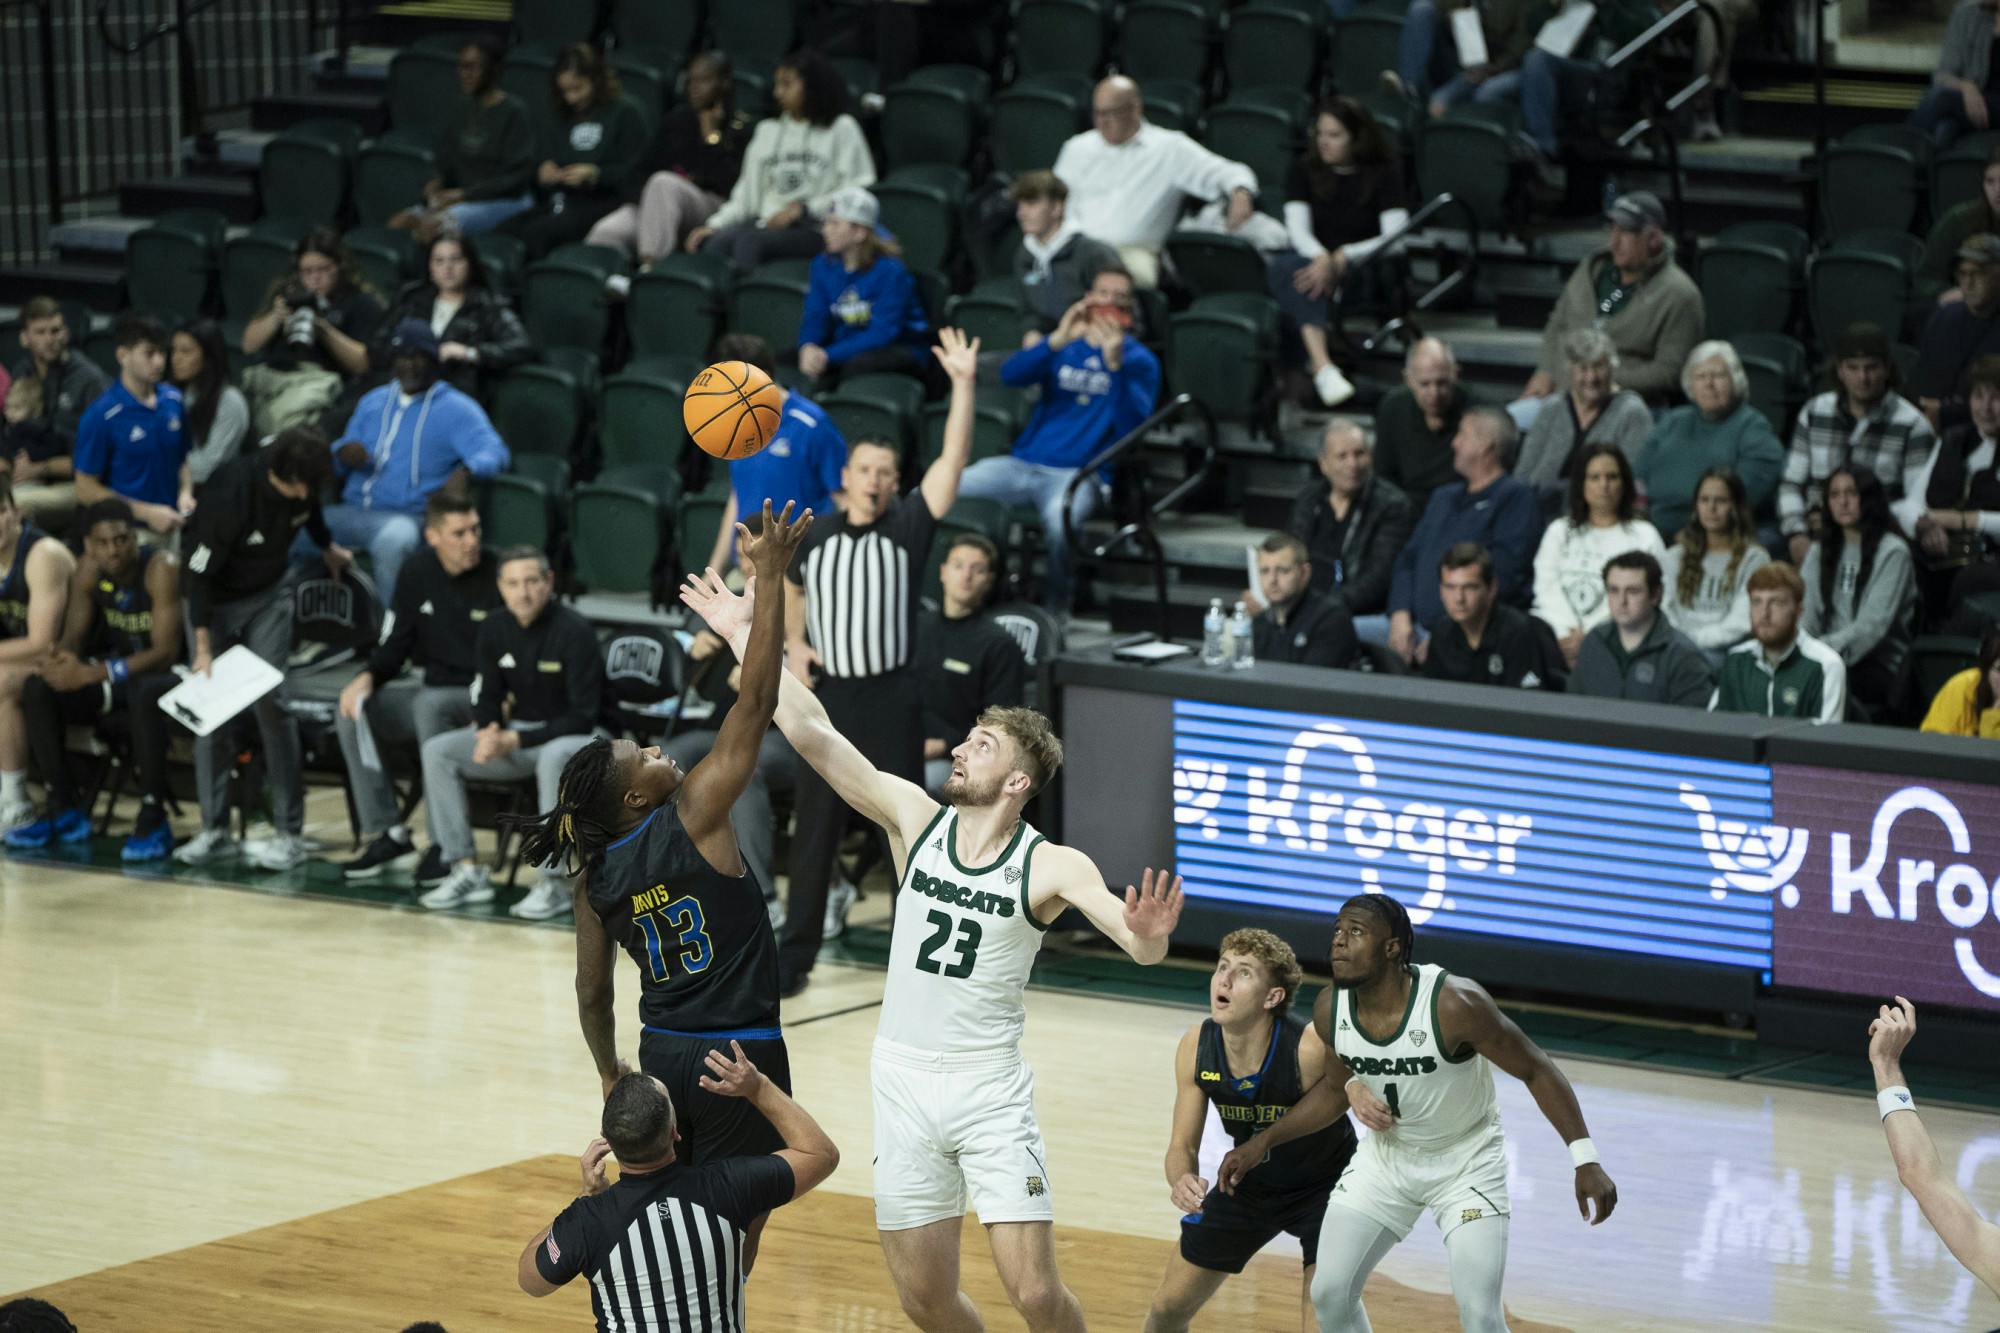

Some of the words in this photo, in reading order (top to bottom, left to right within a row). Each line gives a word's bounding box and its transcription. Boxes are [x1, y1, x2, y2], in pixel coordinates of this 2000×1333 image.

[606, 635, 664, 686] OHIO
[1247, 723, 1532, 925] Kroger
[632, 884, 669, 914] DAVIS
[911, 867, 1017, 918] BOBCATS
[1831, 786, 2000, 999] Kro
[632, 895, 714, 983] 13
[915, 908, 983, 979] 23
[1201, 1071, 1221, 1081] CAA
[1383, 1083, 1402, 1119] 1
[1256, 1105, 1292, 1124] EN
